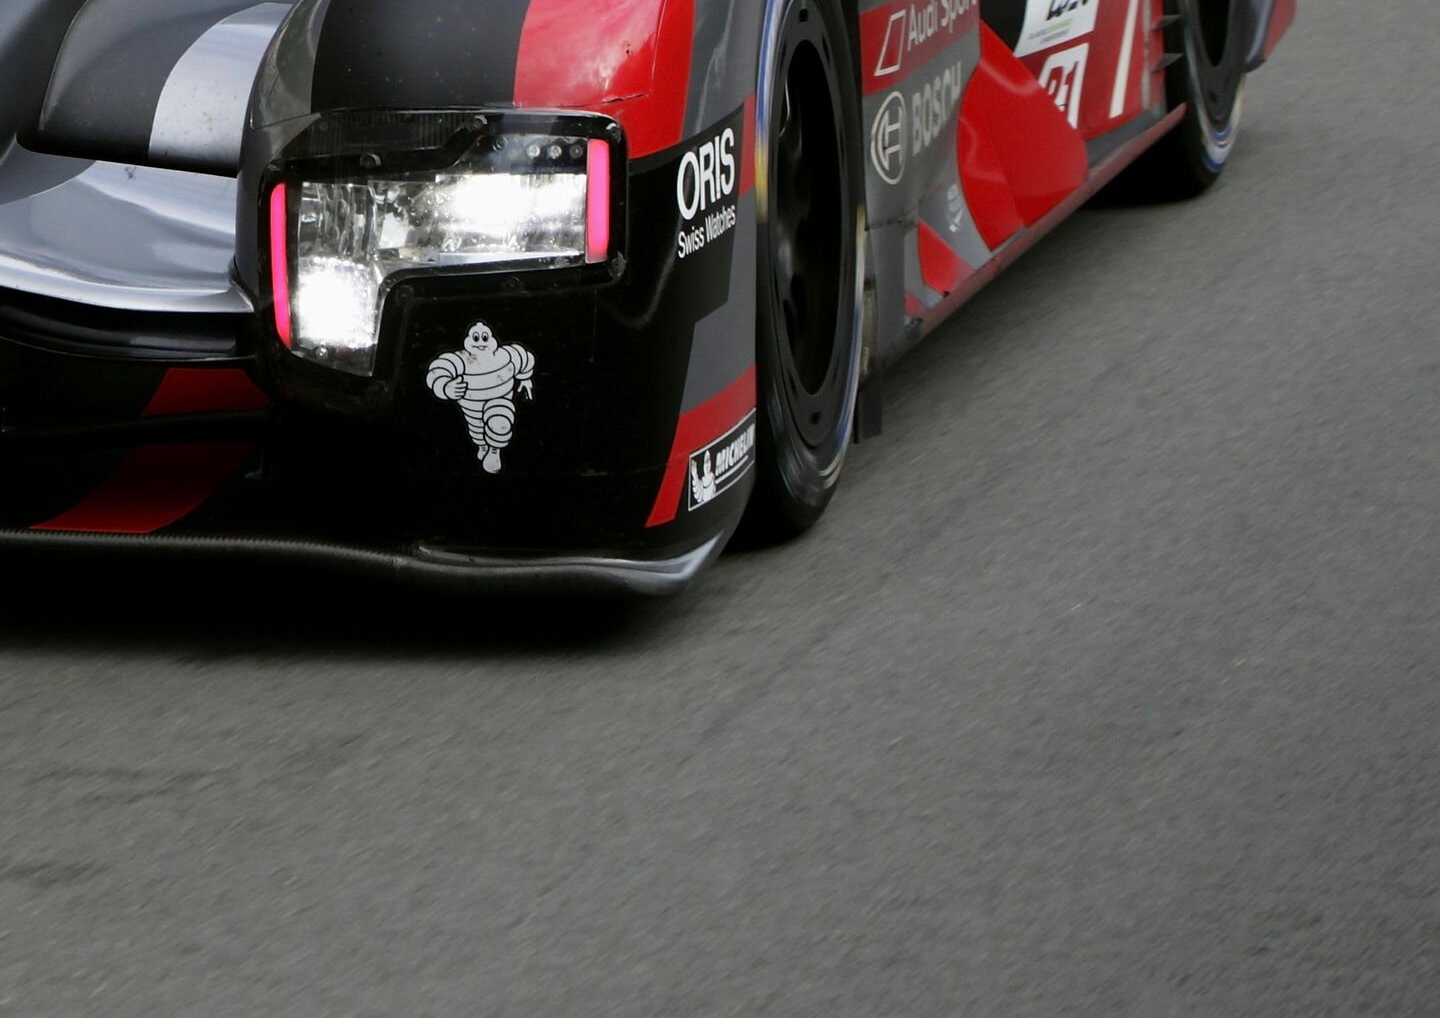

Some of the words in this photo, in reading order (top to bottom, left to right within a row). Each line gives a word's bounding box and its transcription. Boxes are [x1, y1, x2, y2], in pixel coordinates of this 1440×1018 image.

[912, 61, 962, 157] BOSCH
[676, 127, 735, 221] ORIS
[677, 225, 705, 259] Swiss
[705, 204, 736, 243] Watches
